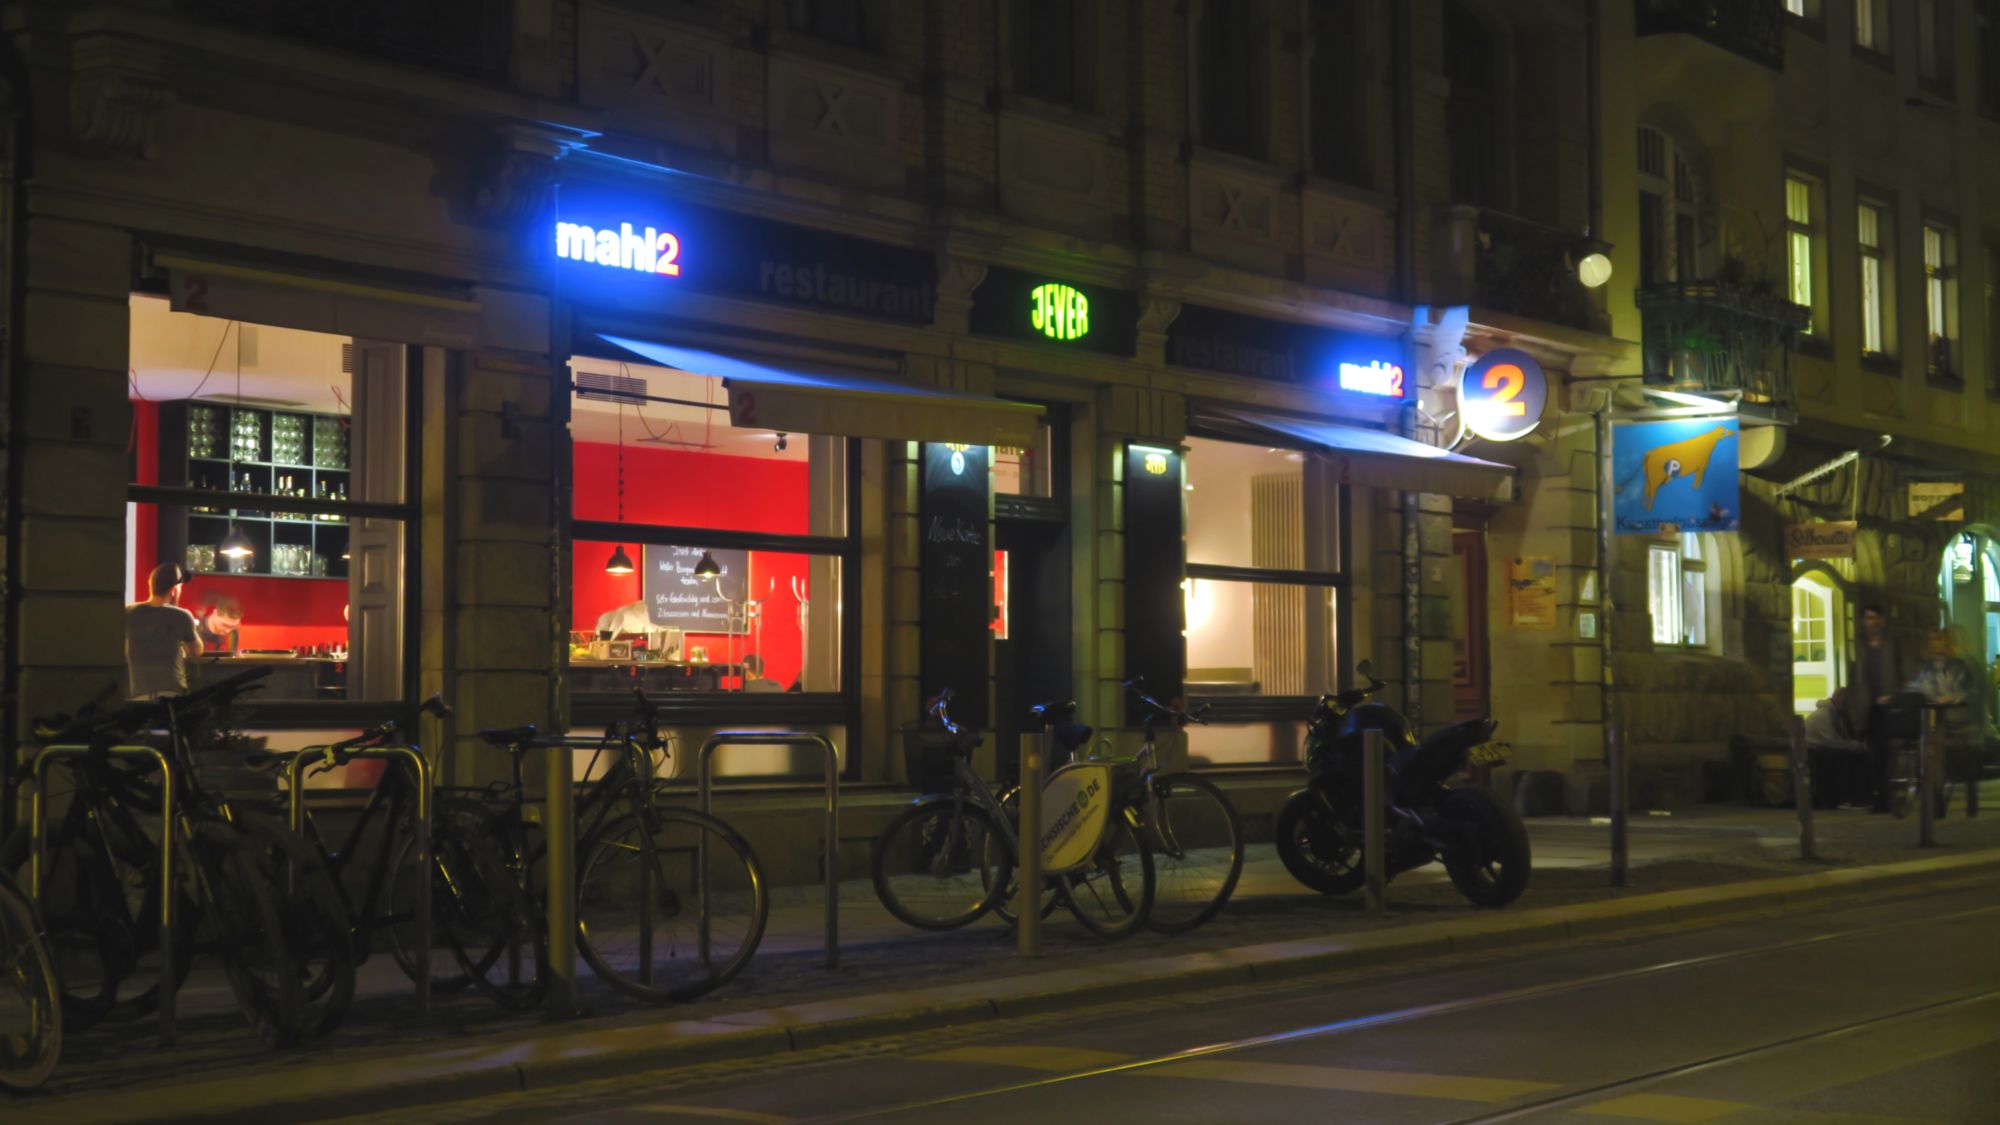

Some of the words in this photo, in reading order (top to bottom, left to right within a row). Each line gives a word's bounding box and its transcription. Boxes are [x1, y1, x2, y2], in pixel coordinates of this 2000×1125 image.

[556, 221, 681, 276] mahl2
[184, 276, 208, 310] 2
[759, 260, 932, 319] restaurant
[1031, 283, 1089, 341] JEVER
[1174, 334, 1297, 379] restaurant
[738, 393, 756, 424] 2
[1482, 363, 1526, 416] 2
[1086, 779, 1101, 797] DE
